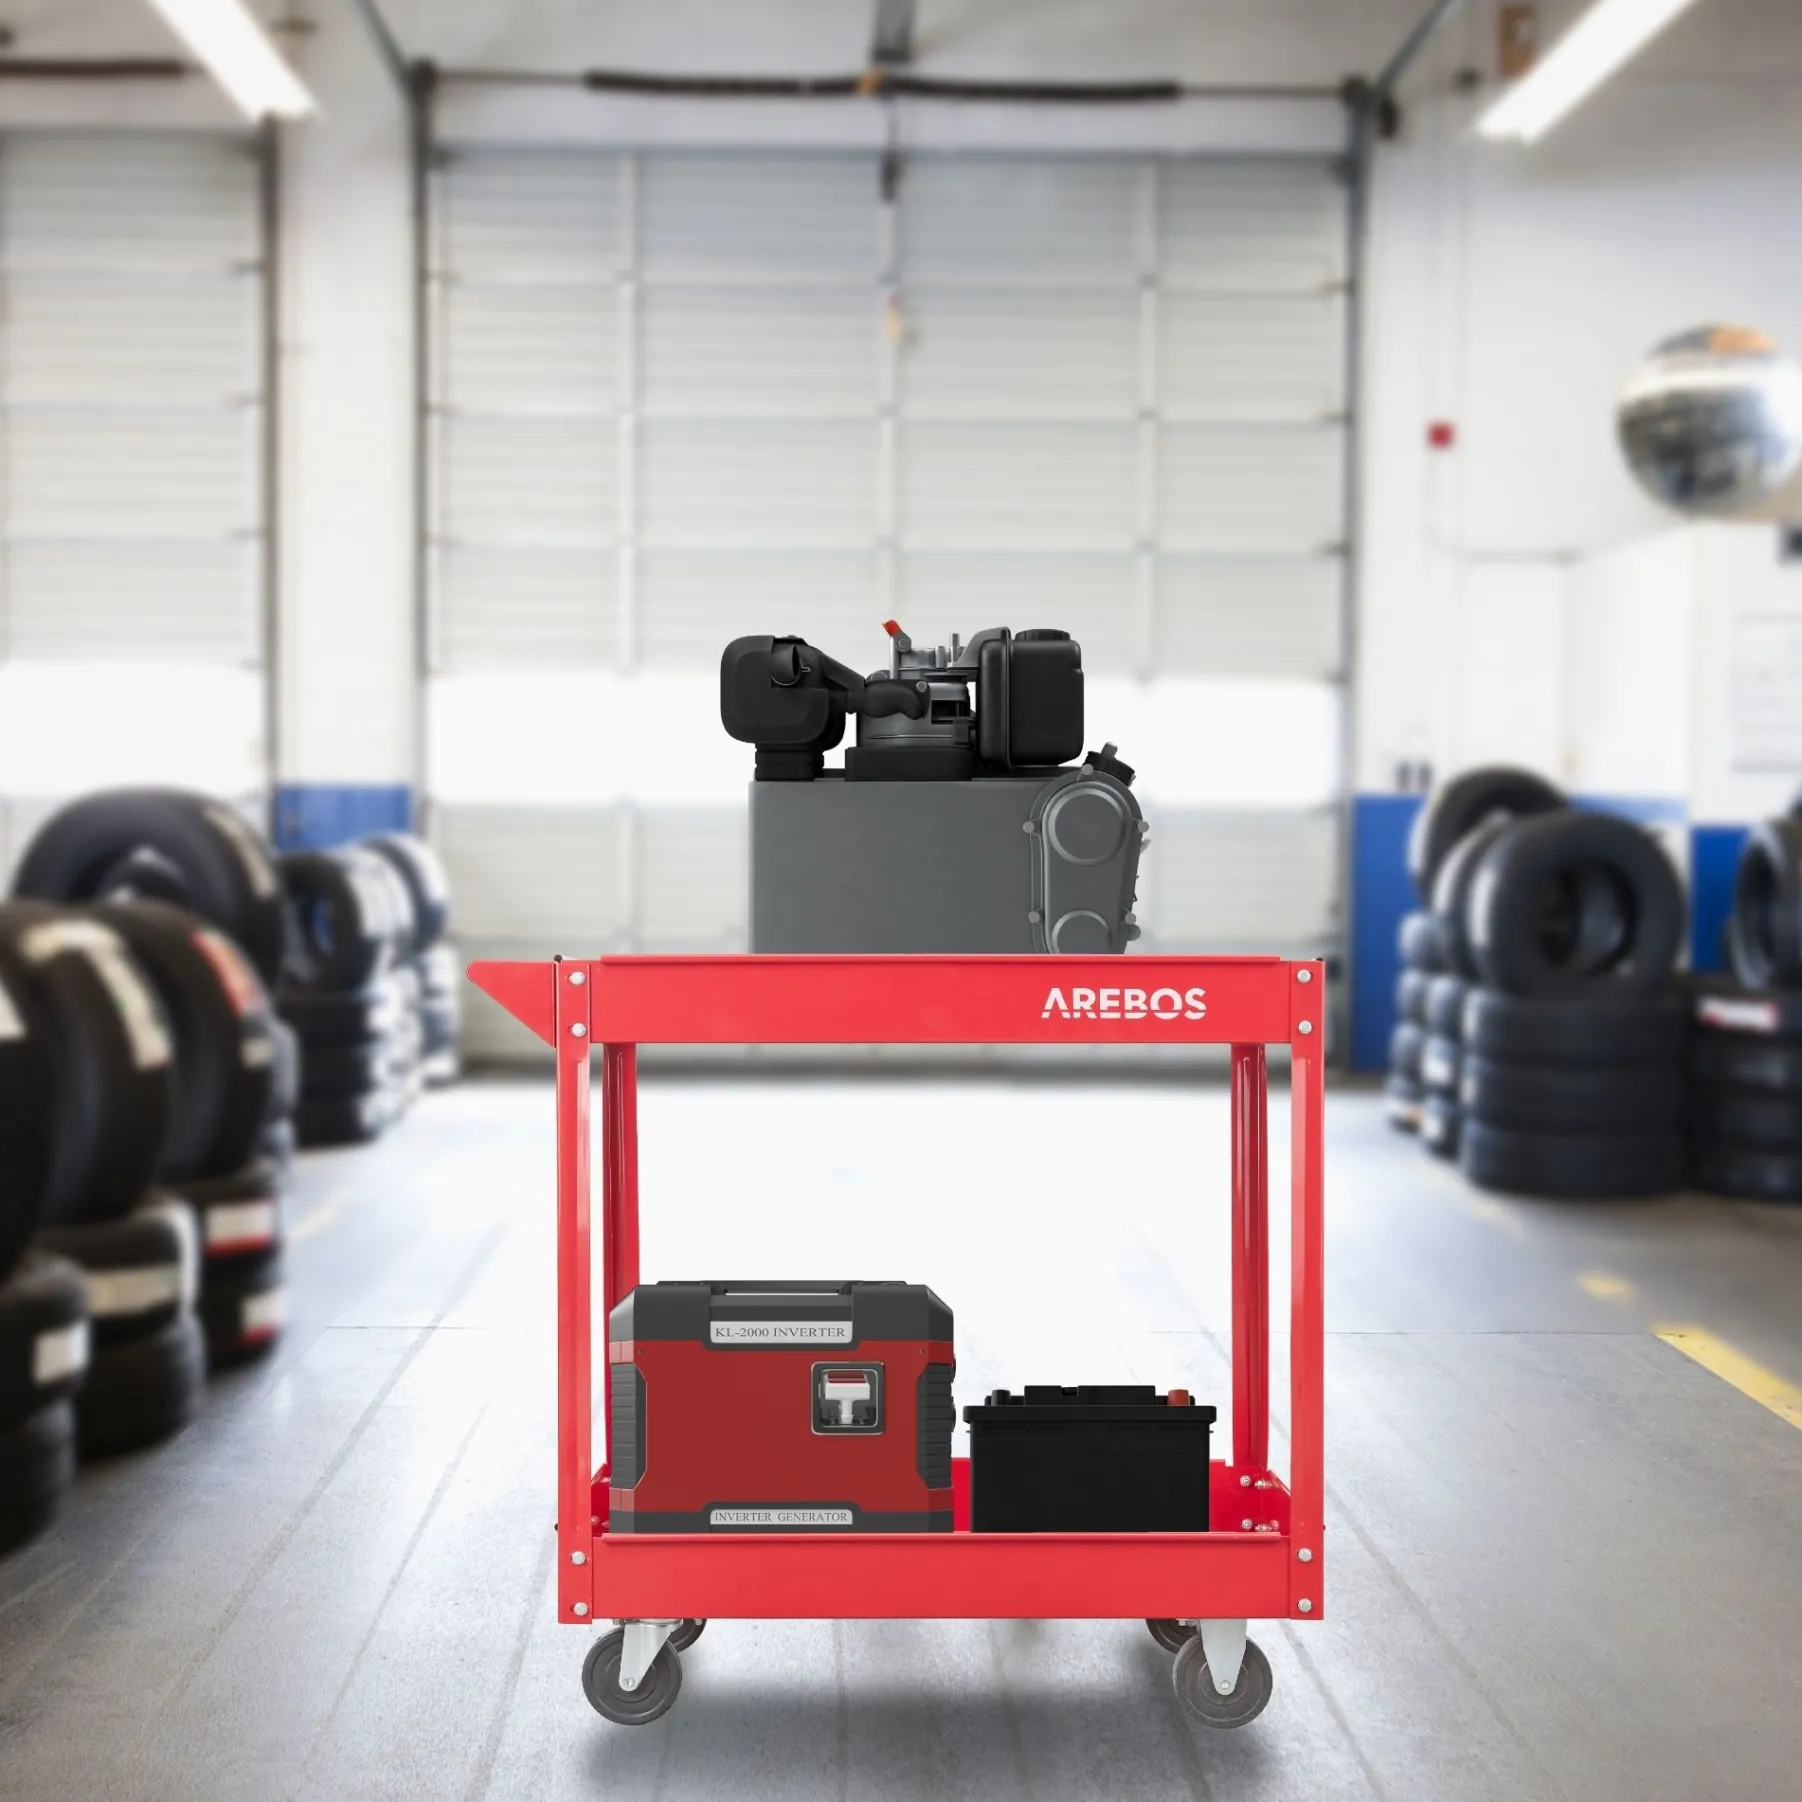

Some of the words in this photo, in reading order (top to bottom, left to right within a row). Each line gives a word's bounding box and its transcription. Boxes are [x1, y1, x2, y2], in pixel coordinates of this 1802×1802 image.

[1041, 987, 1207, 1020] AREBOS
[715, 1327, 769, 1338] KL-2000
[773, 1327, 846, 1338] INVERTER
[715, 1512, 772, 1522] INVERTER
[777, 1512, 848, 1522] GENERATOR
